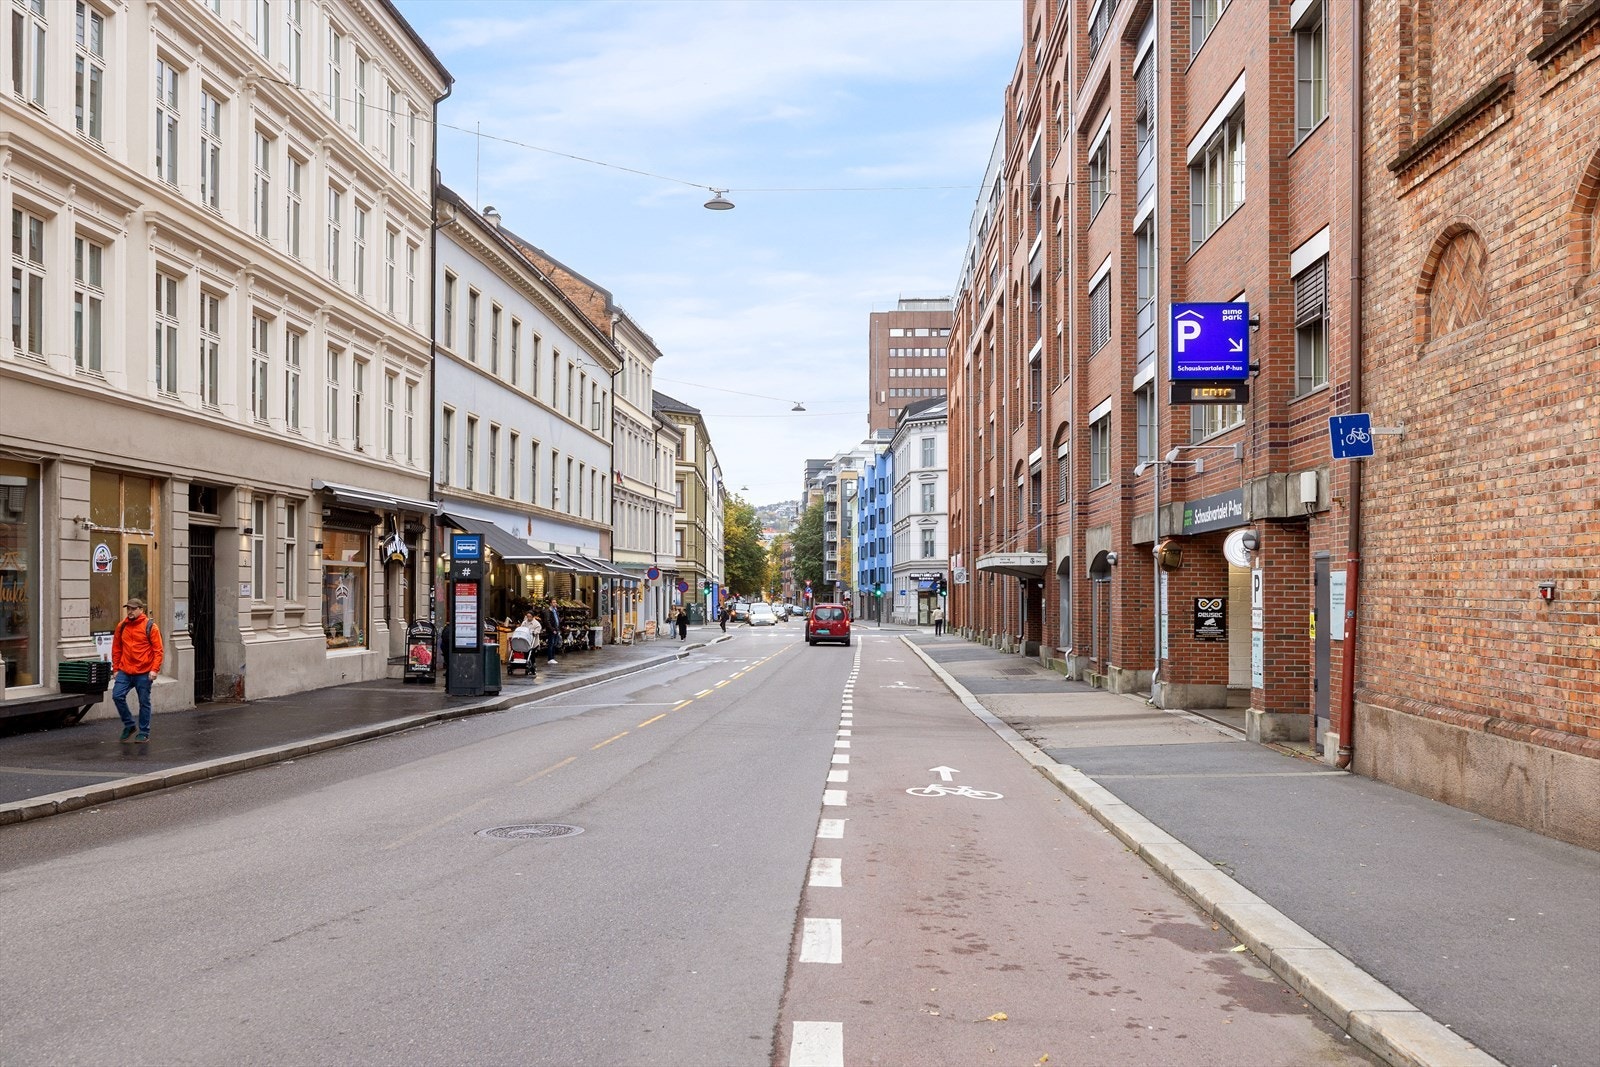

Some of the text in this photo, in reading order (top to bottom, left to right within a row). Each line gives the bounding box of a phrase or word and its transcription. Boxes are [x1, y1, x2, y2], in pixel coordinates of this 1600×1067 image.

[1222, 314, 1243, 322] park
[1177, 320, 1201, 353] P
[1228, 499, 1243, 518] P-hus
[1254, 574, 1260, 603] P
